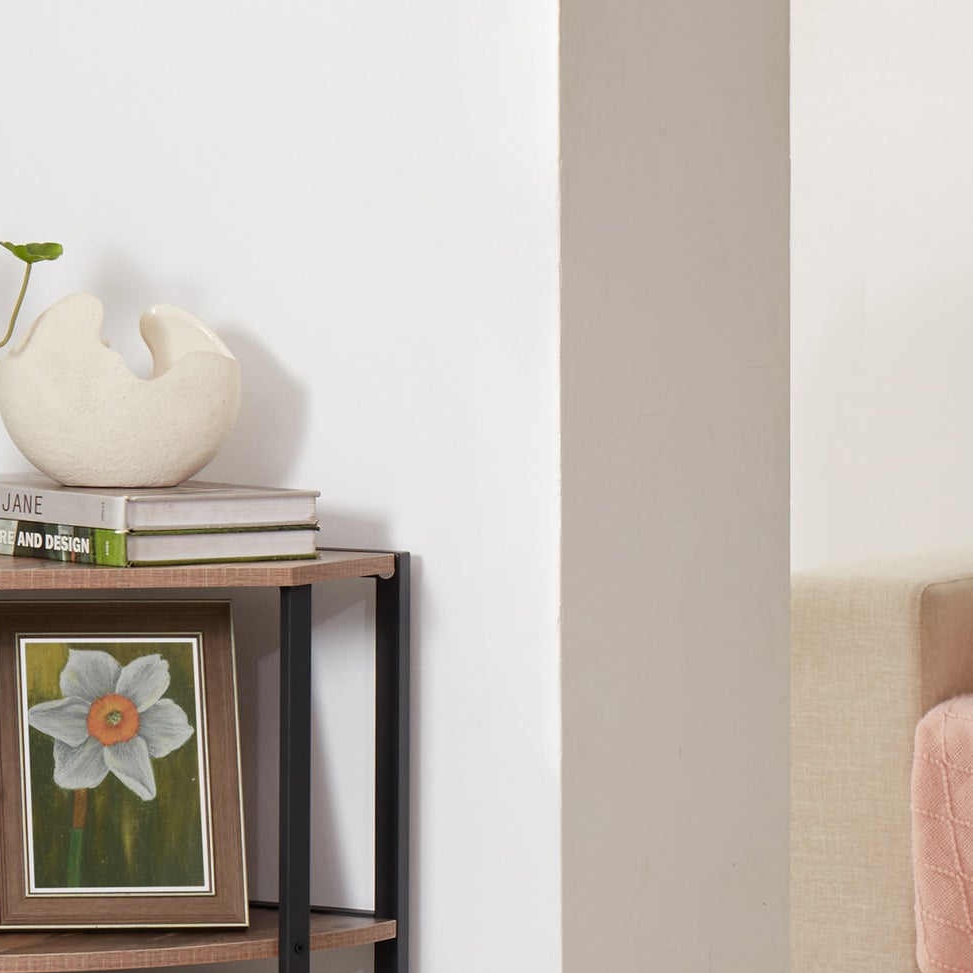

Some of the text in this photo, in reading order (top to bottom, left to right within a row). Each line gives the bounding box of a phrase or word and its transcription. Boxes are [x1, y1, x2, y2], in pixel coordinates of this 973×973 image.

[2, 492, 44, 515] JANE
[17, 531, 43, 549] AND
[44, 534, 90, 554] DESIGN
